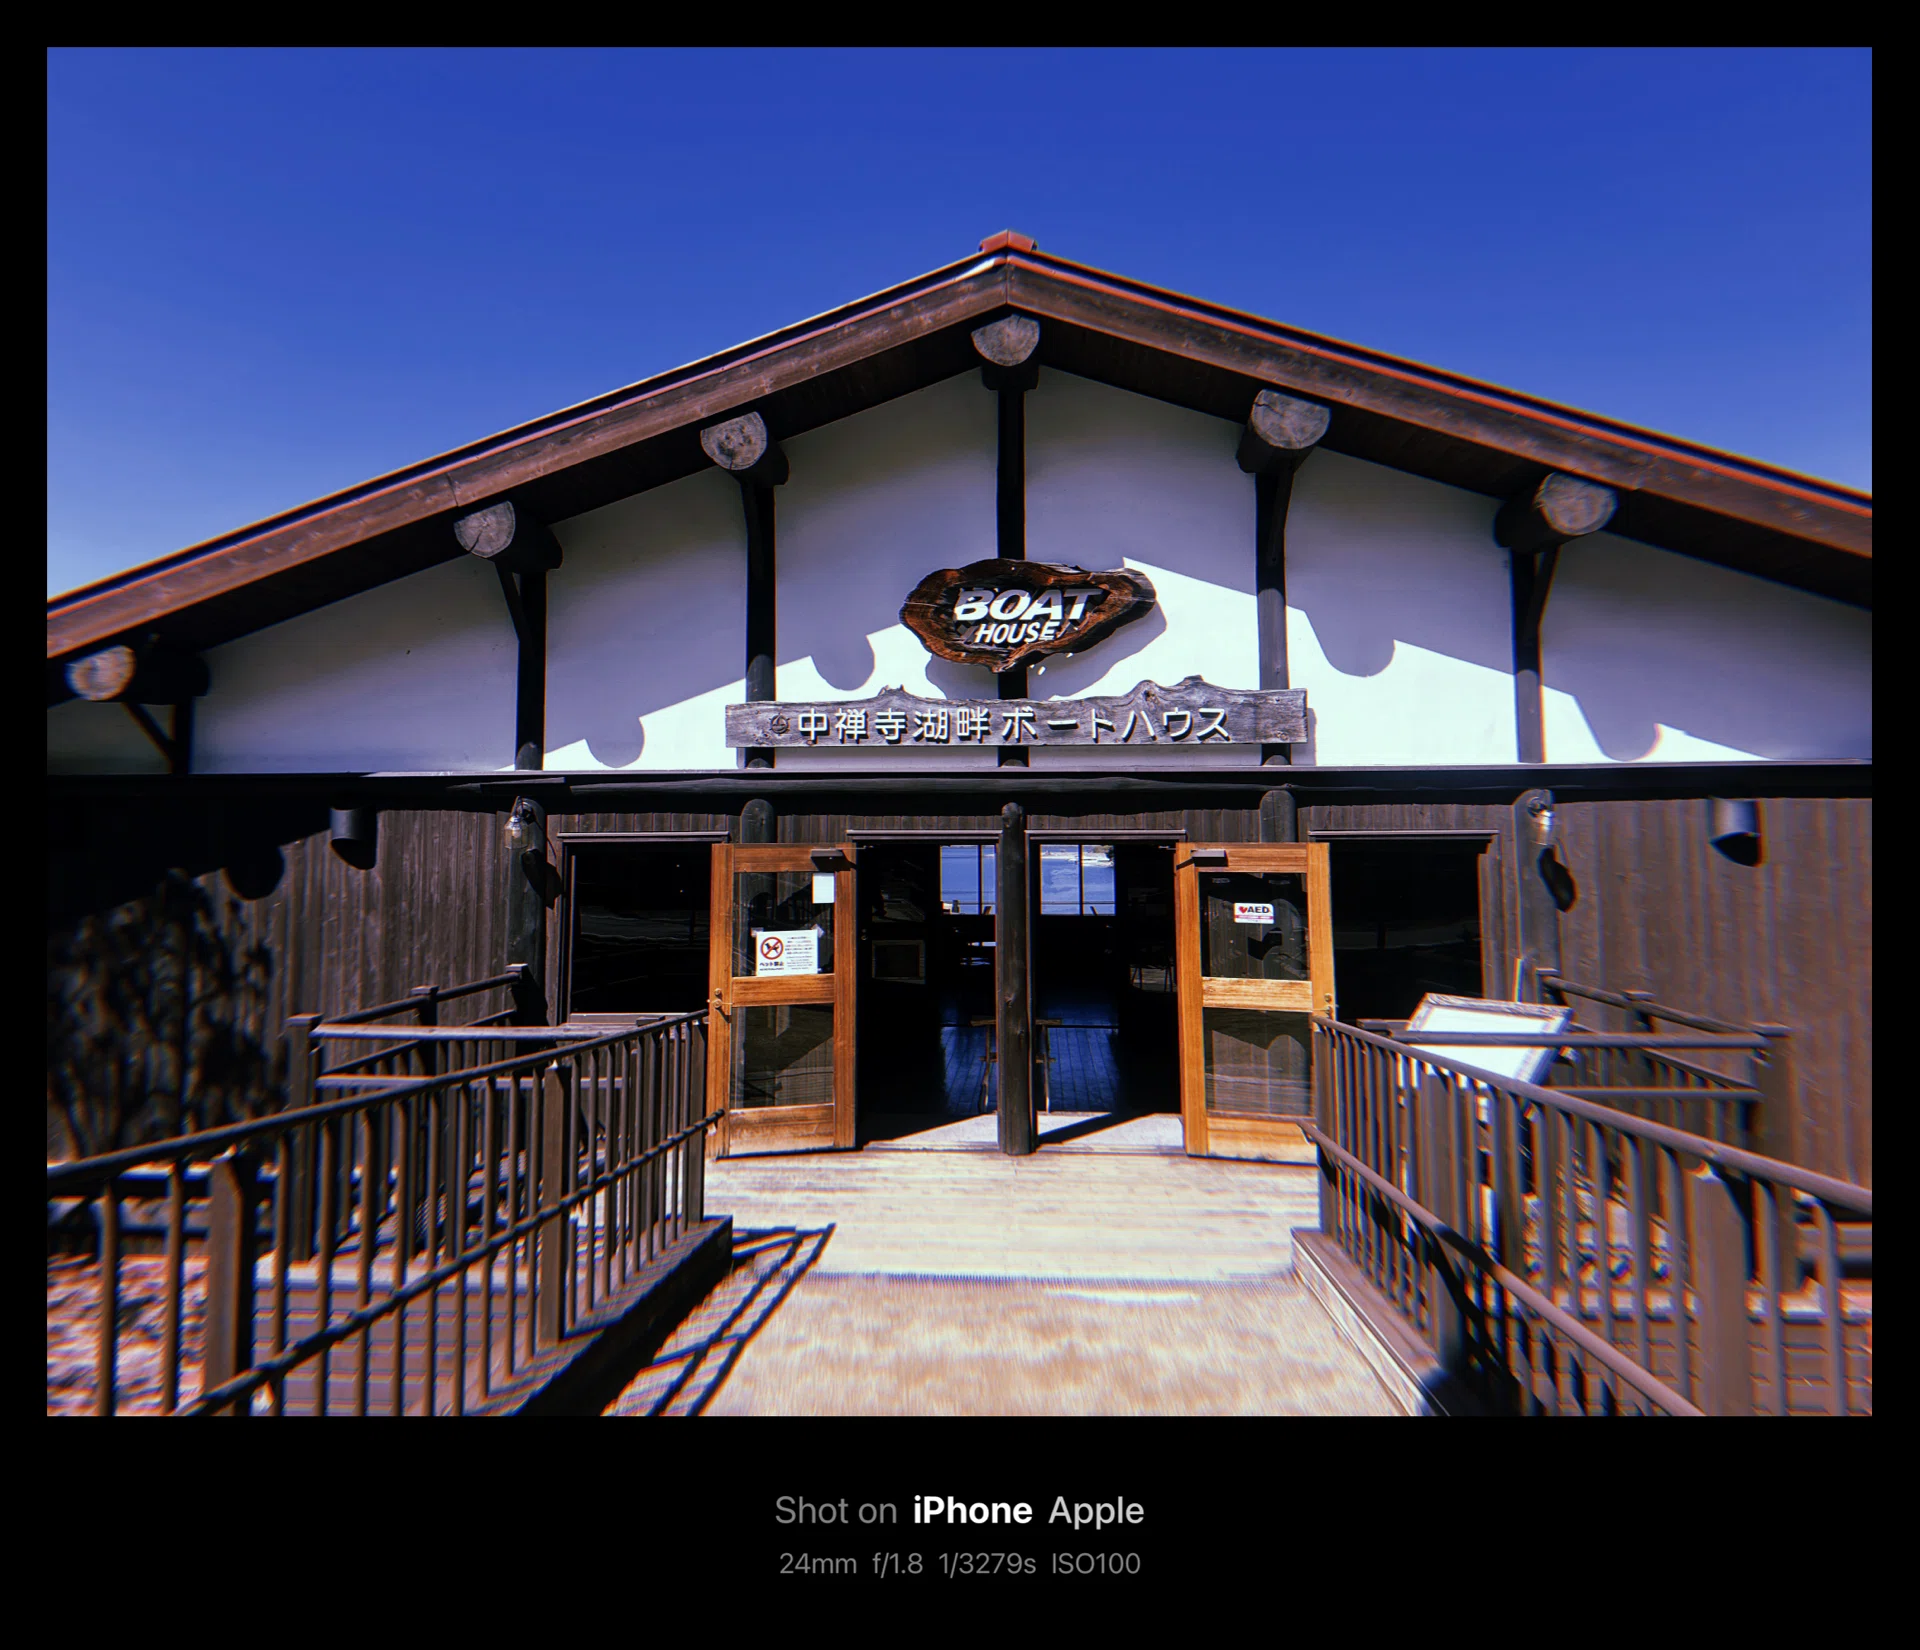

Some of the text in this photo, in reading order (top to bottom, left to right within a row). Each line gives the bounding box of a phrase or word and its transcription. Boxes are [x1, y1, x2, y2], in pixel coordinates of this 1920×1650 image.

[953, 588, 1103, 621] BOAT
[974, 621, 1060, 645] HOUSE
[798, 706, 1231, 742] 中禅寺湖畔ボートハウス
[1247, 906, 1270, 914] AED
